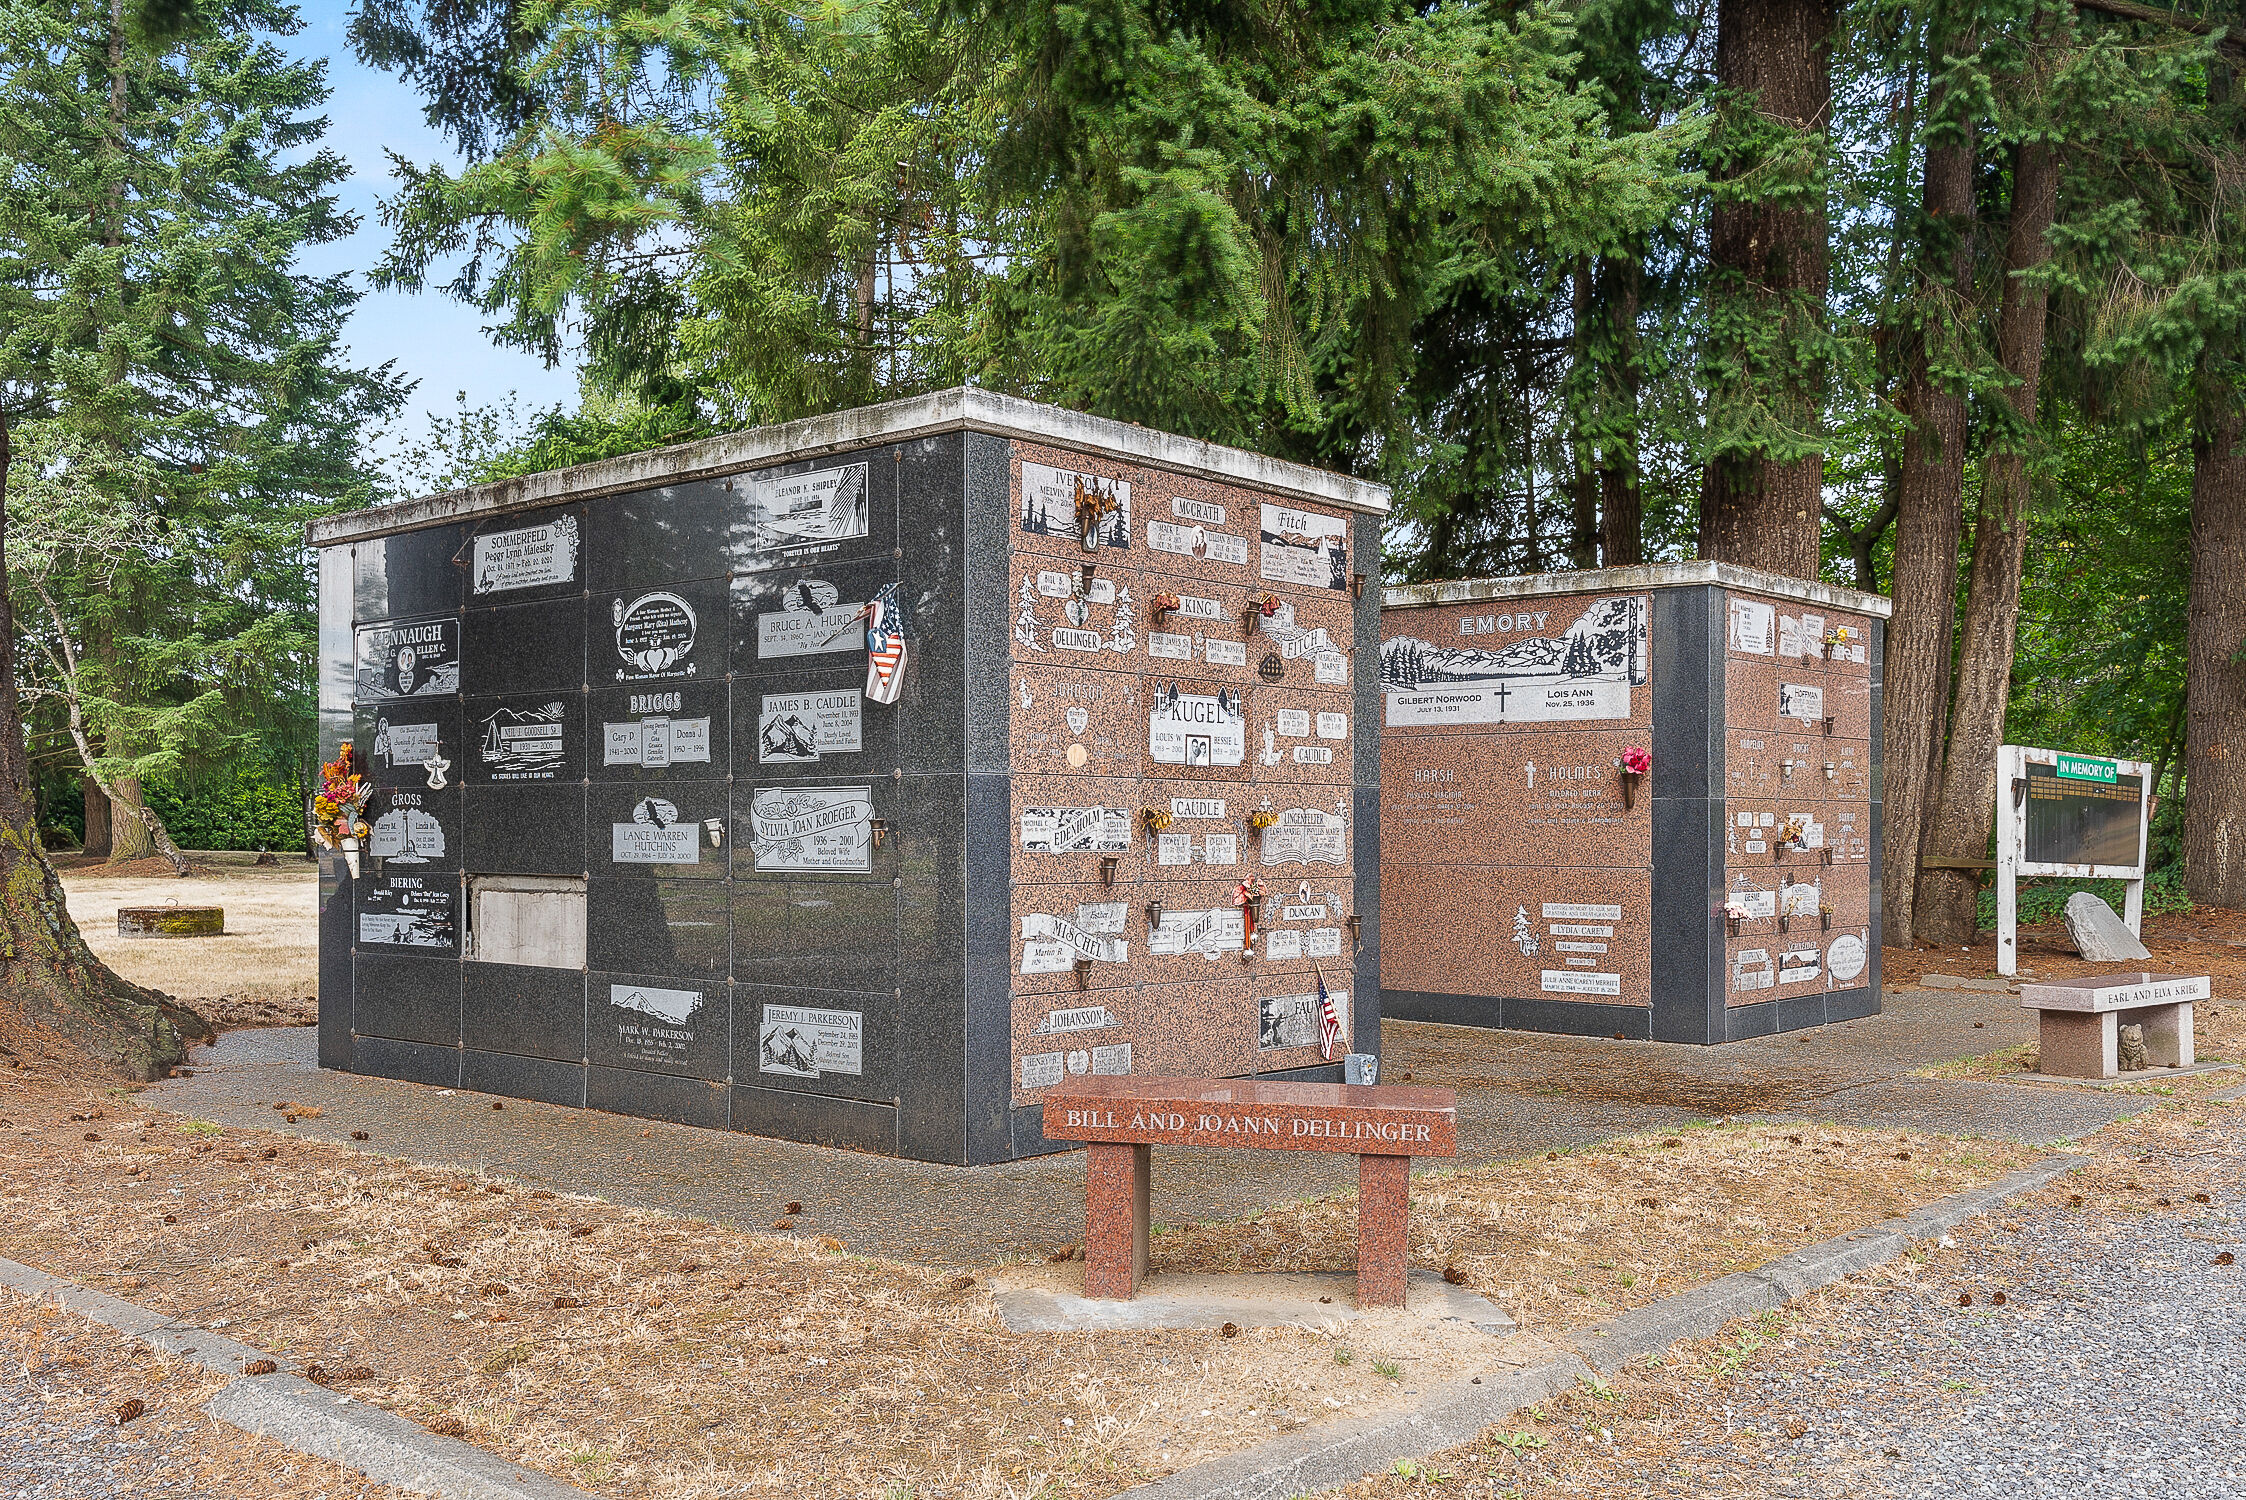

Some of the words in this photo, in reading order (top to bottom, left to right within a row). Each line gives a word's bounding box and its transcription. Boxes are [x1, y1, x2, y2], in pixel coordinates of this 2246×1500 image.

[812, 479, 838, 491] SHIPLEY
[1278, 512, 1307, 530] Fitch
[491, 530, 547, 549] SOMMERFELD
[506, 548, 521, 560] Lynn
[1185, 599, 1212, 615] KING
[770, 620, 800, 632] BRUCE
[805, 619, 815, 629] A.
[821, 614, 851, 627] HURD
[1459, 611, 1549, 635] EMORY
[1056, 630, 1098, 649] DELLINGER
[1287, 631, 1318, 656] FITCH
[416, 644, 438, 655] ELLEN
[440, 643, 446, 652] C.
[630, 692, 681, 713] BRIGGS
[769, 700, 799, 712] JAMES
[804, 700, 812, 710] B.
[816, 696, 856, 709] CAUDLE
[817, 711, 840, 719] November
[1172, 700, 1224, 724] KUGEL
[524, 726, 548, 736] GOODSELL
[823, 720, 833, 728] June
[676, 729, 695, 739] Donna
[1299, 748, 1327, 763] CAUDLE
[1415, 770, 1453, 782] HARSH
[1549, 766, 1601, 780] HOLMES
[2060, 760, 2069, 773] IN
[2071, 762, 2103, 777] MEMORY
[2104, 766, 2115, 778] OF
[392, 793, 421, 806] GROSS
[1176, 801, 1220, 816] CAUDLE
[379, 822, 390, 831] Larry
[760, 820, 789, 837] SYLVIA
[792, 816, 813, 834] JOAN
[815, 805, 857, 828] KROEGER
[1054, 809, 1100, 846] EDENHOLM
[623, 831, 649, 840] LANCE
[653, 831, 688, 840] WARREN
[839, 835, 854, 846] 2001
[634, 841, 676, 851] HUTCHINS
[818, 848, 836, 856] Beloved
[803, 857, 820, 865] Mother
[832, 857, 866, 866] Grandmother
[390, 877, 423, 889] BIERING
[1289, 907, 1320, 918] DUNCAN
[1183, 915, 1212, 949] JUBIE
[1557, 926, 1578, 934] LYDIA
[1582, 927, 1605, 935] CAREY
[1053, 920, 1102, 957] MISCHEL
[2108, 992, 2129, 1003] EARL
[2133, 989, 2151, 1000] AND
[2154, 987, 2171, 998] ELVA
[2175, 984, 2198, 995] KRIEG
[768, 1008, 798, 1024] JEREMY
[809, 1013, 858, 1030] PARKERSON
[1052, 1010, 1102, 1029] JOHANSSON
[619, 1024, 639, 1035] MARK
[653, 1028, 694, 1041] PARKERSON
[818, 1030, 839, 1039] September
[818, 1039, 838, 1047] December
[1066, 1109, 1120, 1128] BILL
[1129, 1110, 1185, 1130] AND
[1292, 1119, 1431, 1142] DELLINGER
